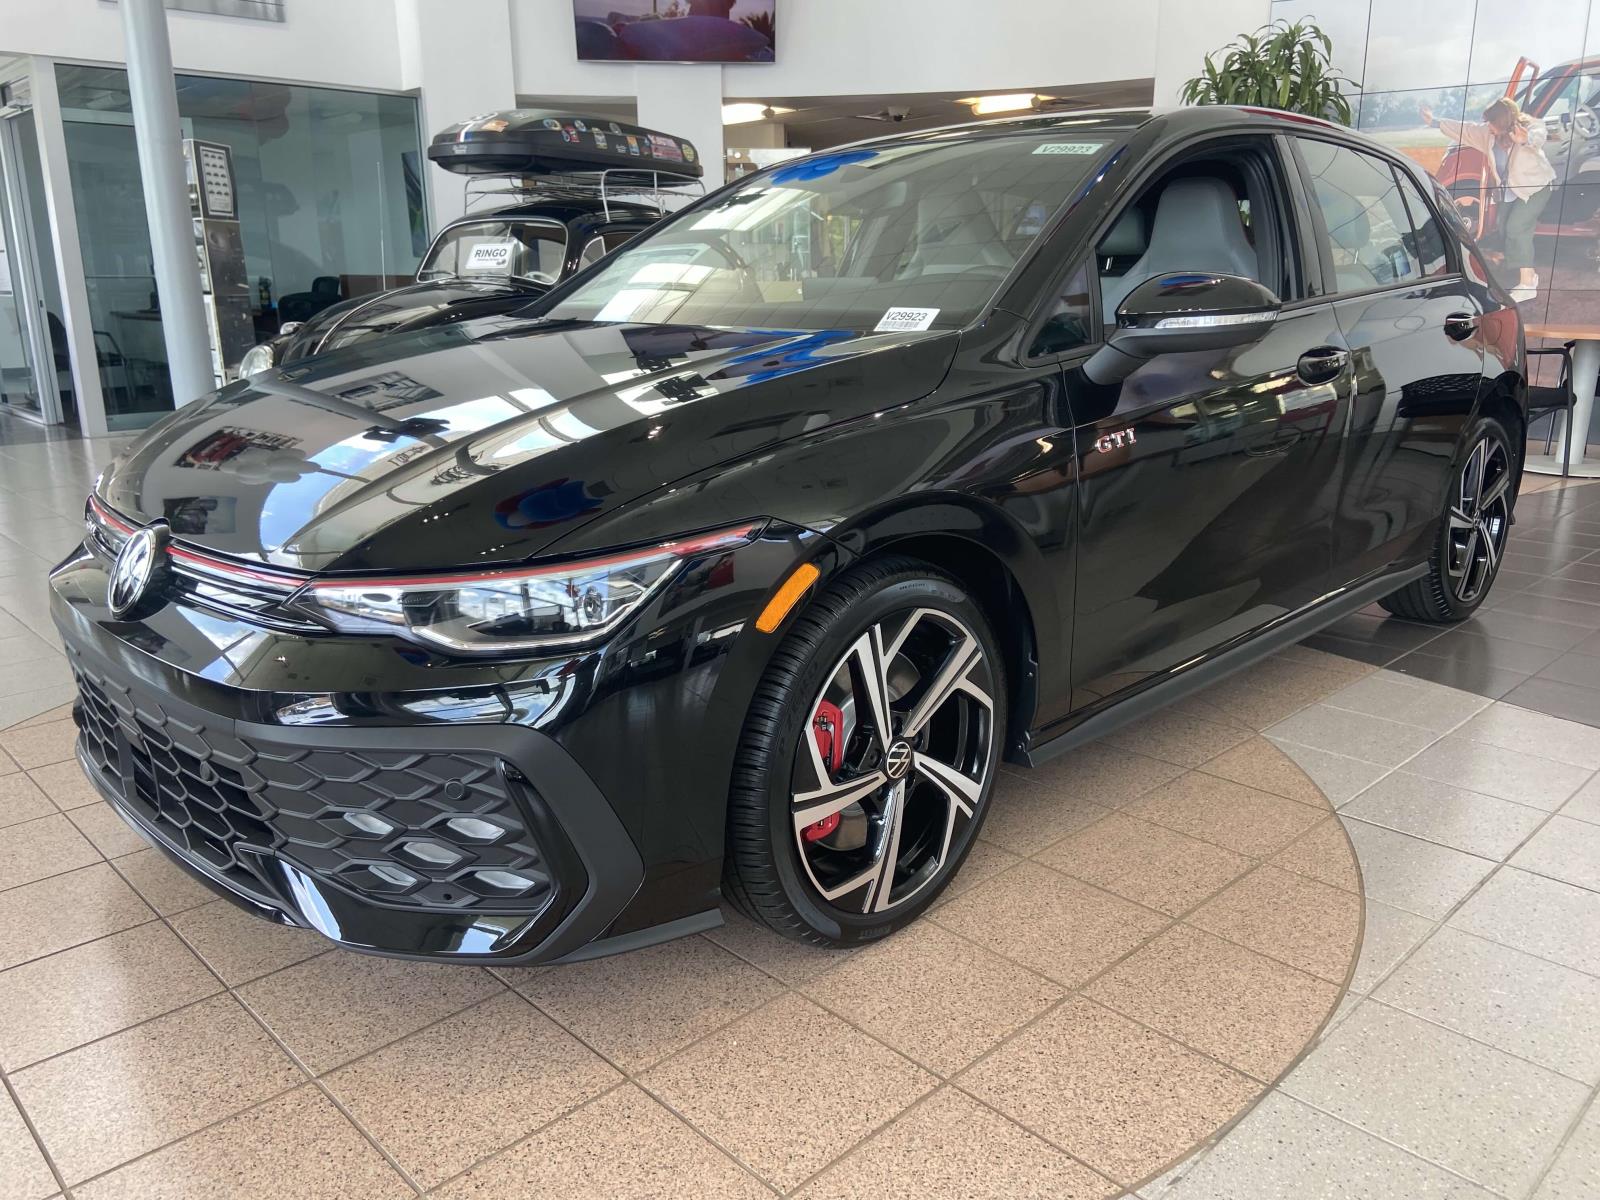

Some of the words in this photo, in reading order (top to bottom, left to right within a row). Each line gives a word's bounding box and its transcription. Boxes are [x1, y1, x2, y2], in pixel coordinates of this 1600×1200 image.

[474, 248, 507, 258] RINGO
[886, 311, 927, 321] V29923
[1095, 428, 1137, 453] GTI
